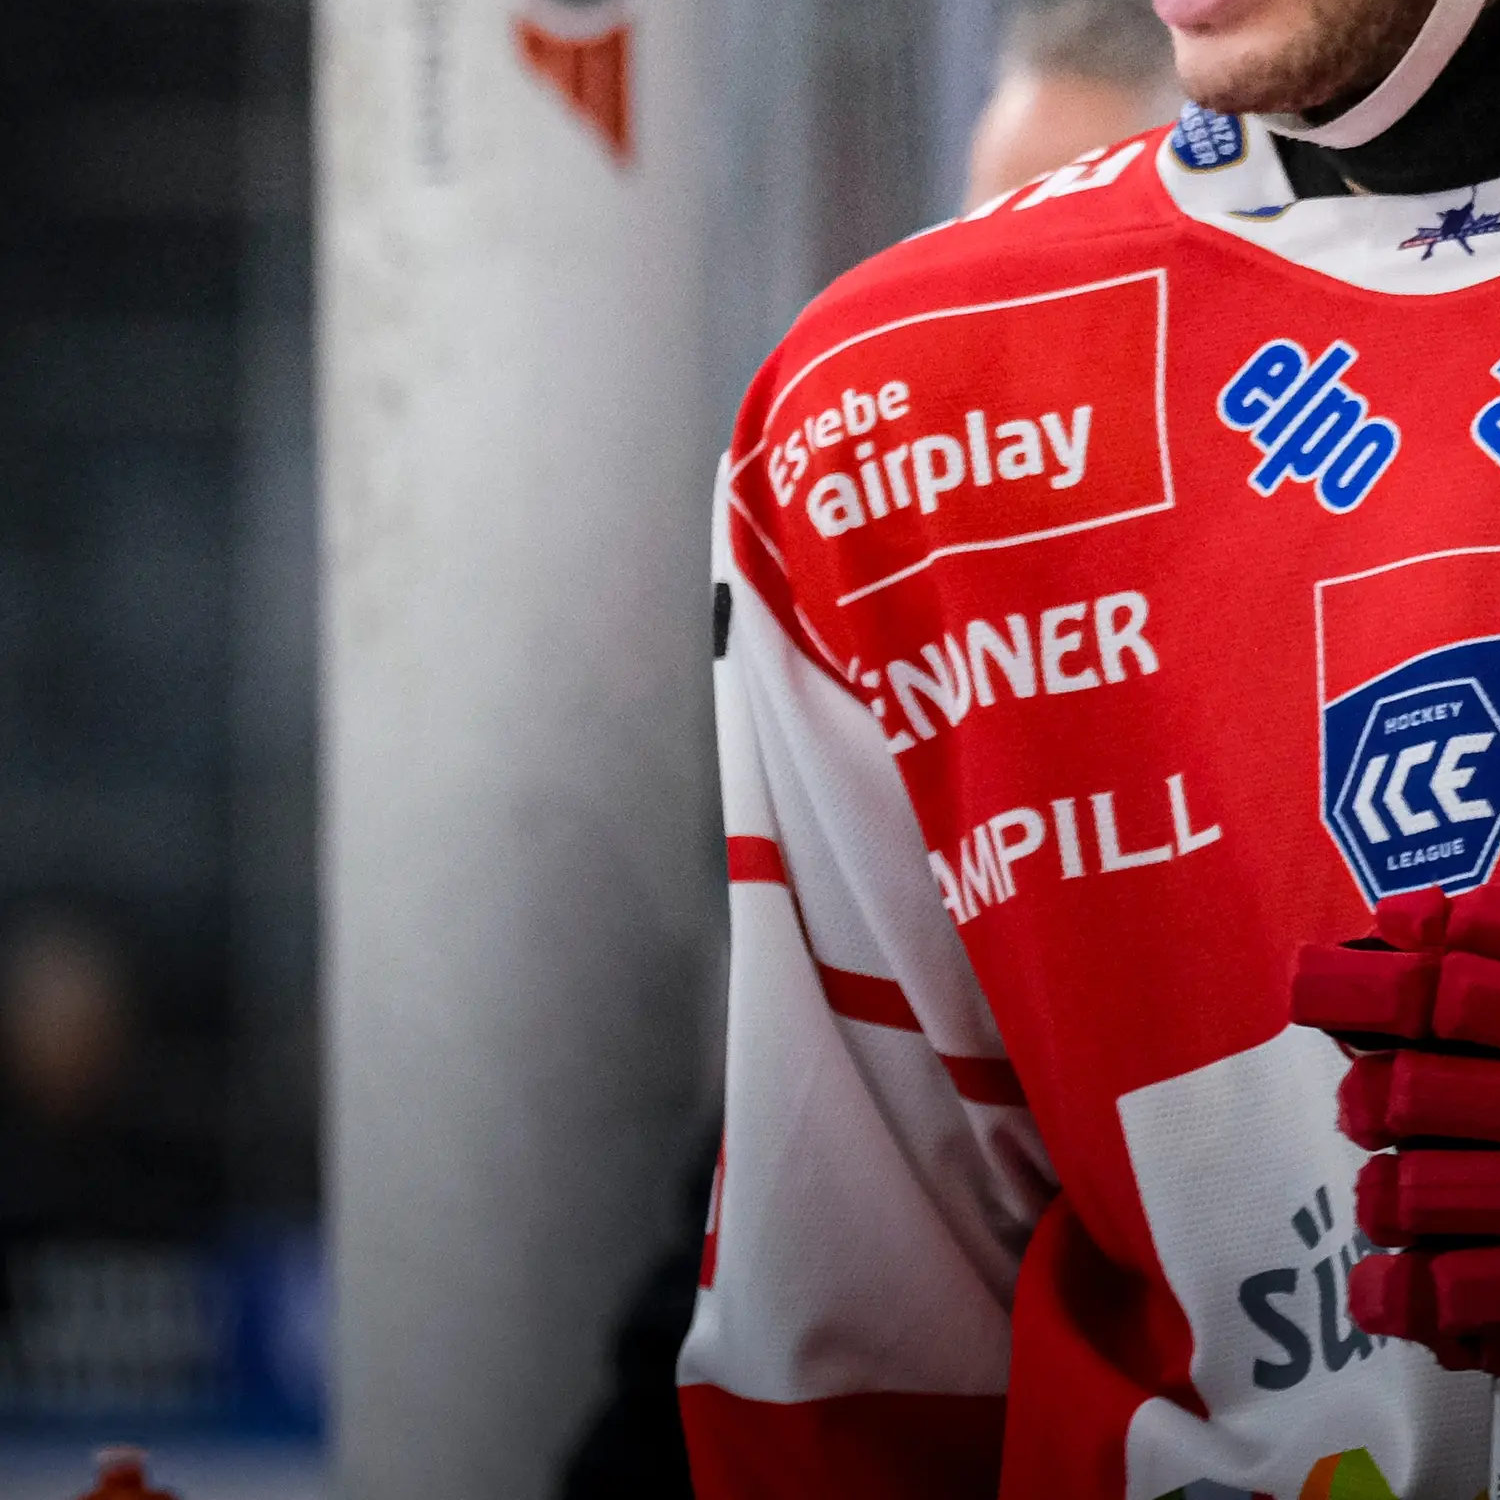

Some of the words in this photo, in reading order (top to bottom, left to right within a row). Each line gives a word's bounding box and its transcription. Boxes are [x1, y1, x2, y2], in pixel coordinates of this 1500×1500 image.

[804, 380, 910, 451] lebe
[1218, 337, 1400, 512] elpo
[805, 404, 1093, 540] airplay
[850, 589, 1160, 756] ENNER
[1385, 701, 1463, 732] HOCKEY
[1353, 733, 1495, 845] ICE
[1387, 838, 1465, 871] LEAGUE
